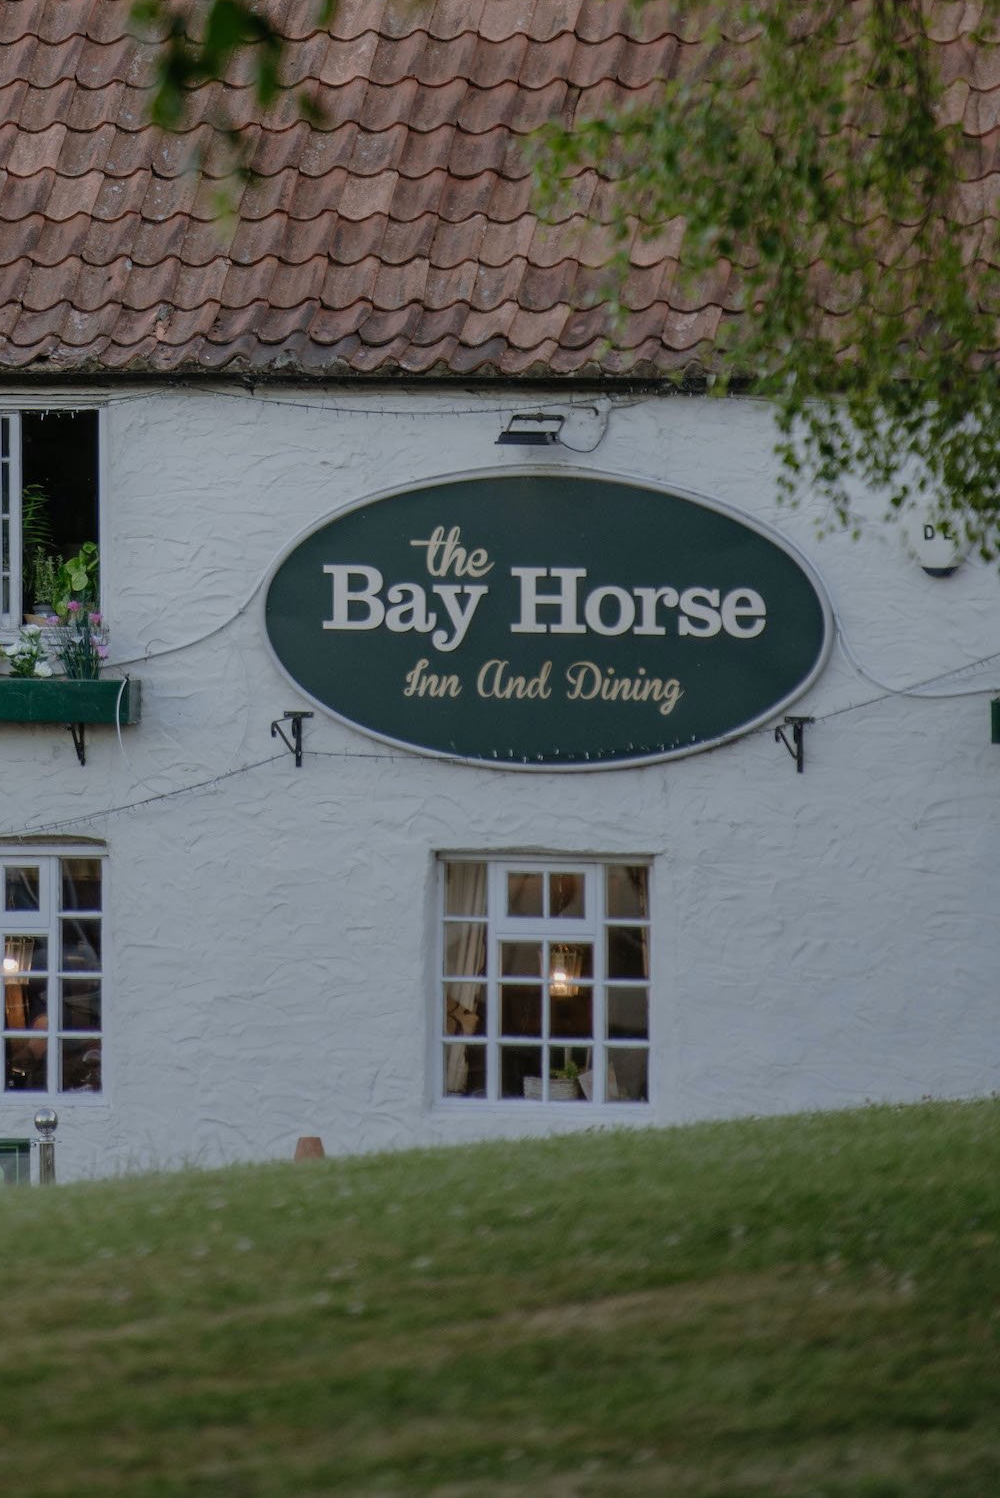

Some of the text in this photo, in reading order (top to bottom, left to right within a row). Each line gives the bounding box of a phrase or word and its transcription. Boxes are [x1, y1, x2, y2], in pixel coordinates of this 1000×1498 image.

[410, 526, 494, 577] the
[322, 564, 767, 652] Bay Horse
[403, 658, 684, 715] Inn And Dining
